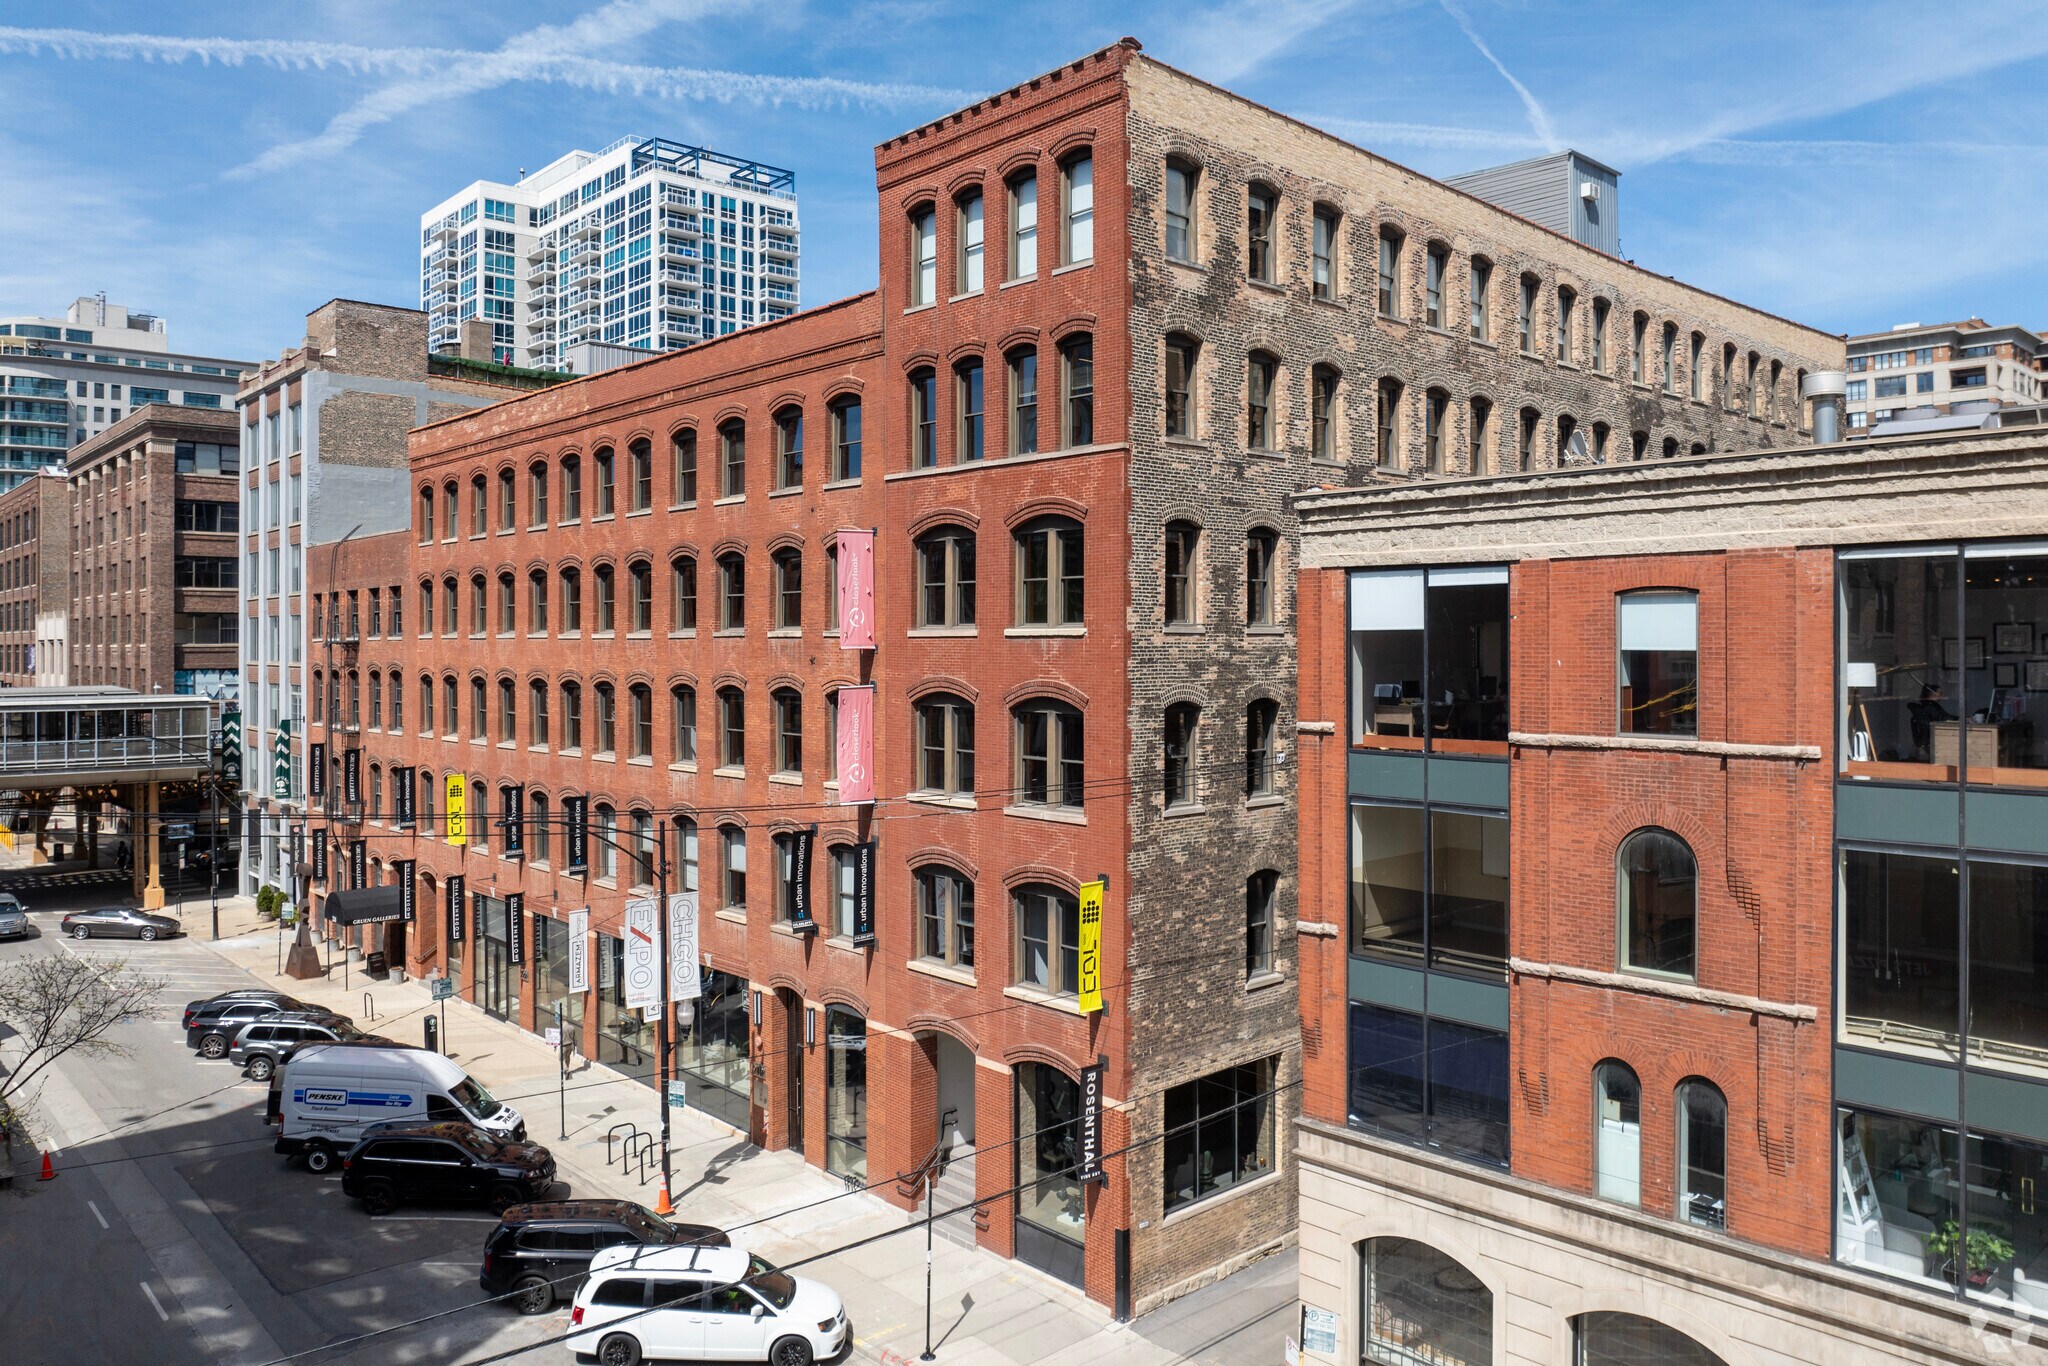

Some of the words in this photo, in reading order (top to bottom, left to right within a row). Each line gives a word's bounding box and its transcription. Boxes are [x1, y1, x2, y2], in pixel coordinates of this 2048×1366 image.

[852, 713, 860, 761] closerlook
[796, 835, 806, 883] innovations
[860, 848, 868, 895] innovations
[371, 914, 400, 924] GALLERIES
[672, 899, 695, 984] CHGO
[629, 904, 653, 989] EXPO
[307, 1093, 345, 1101] PENSKE
[1084, 1071, 1097, 1173] ROSENTHAL
